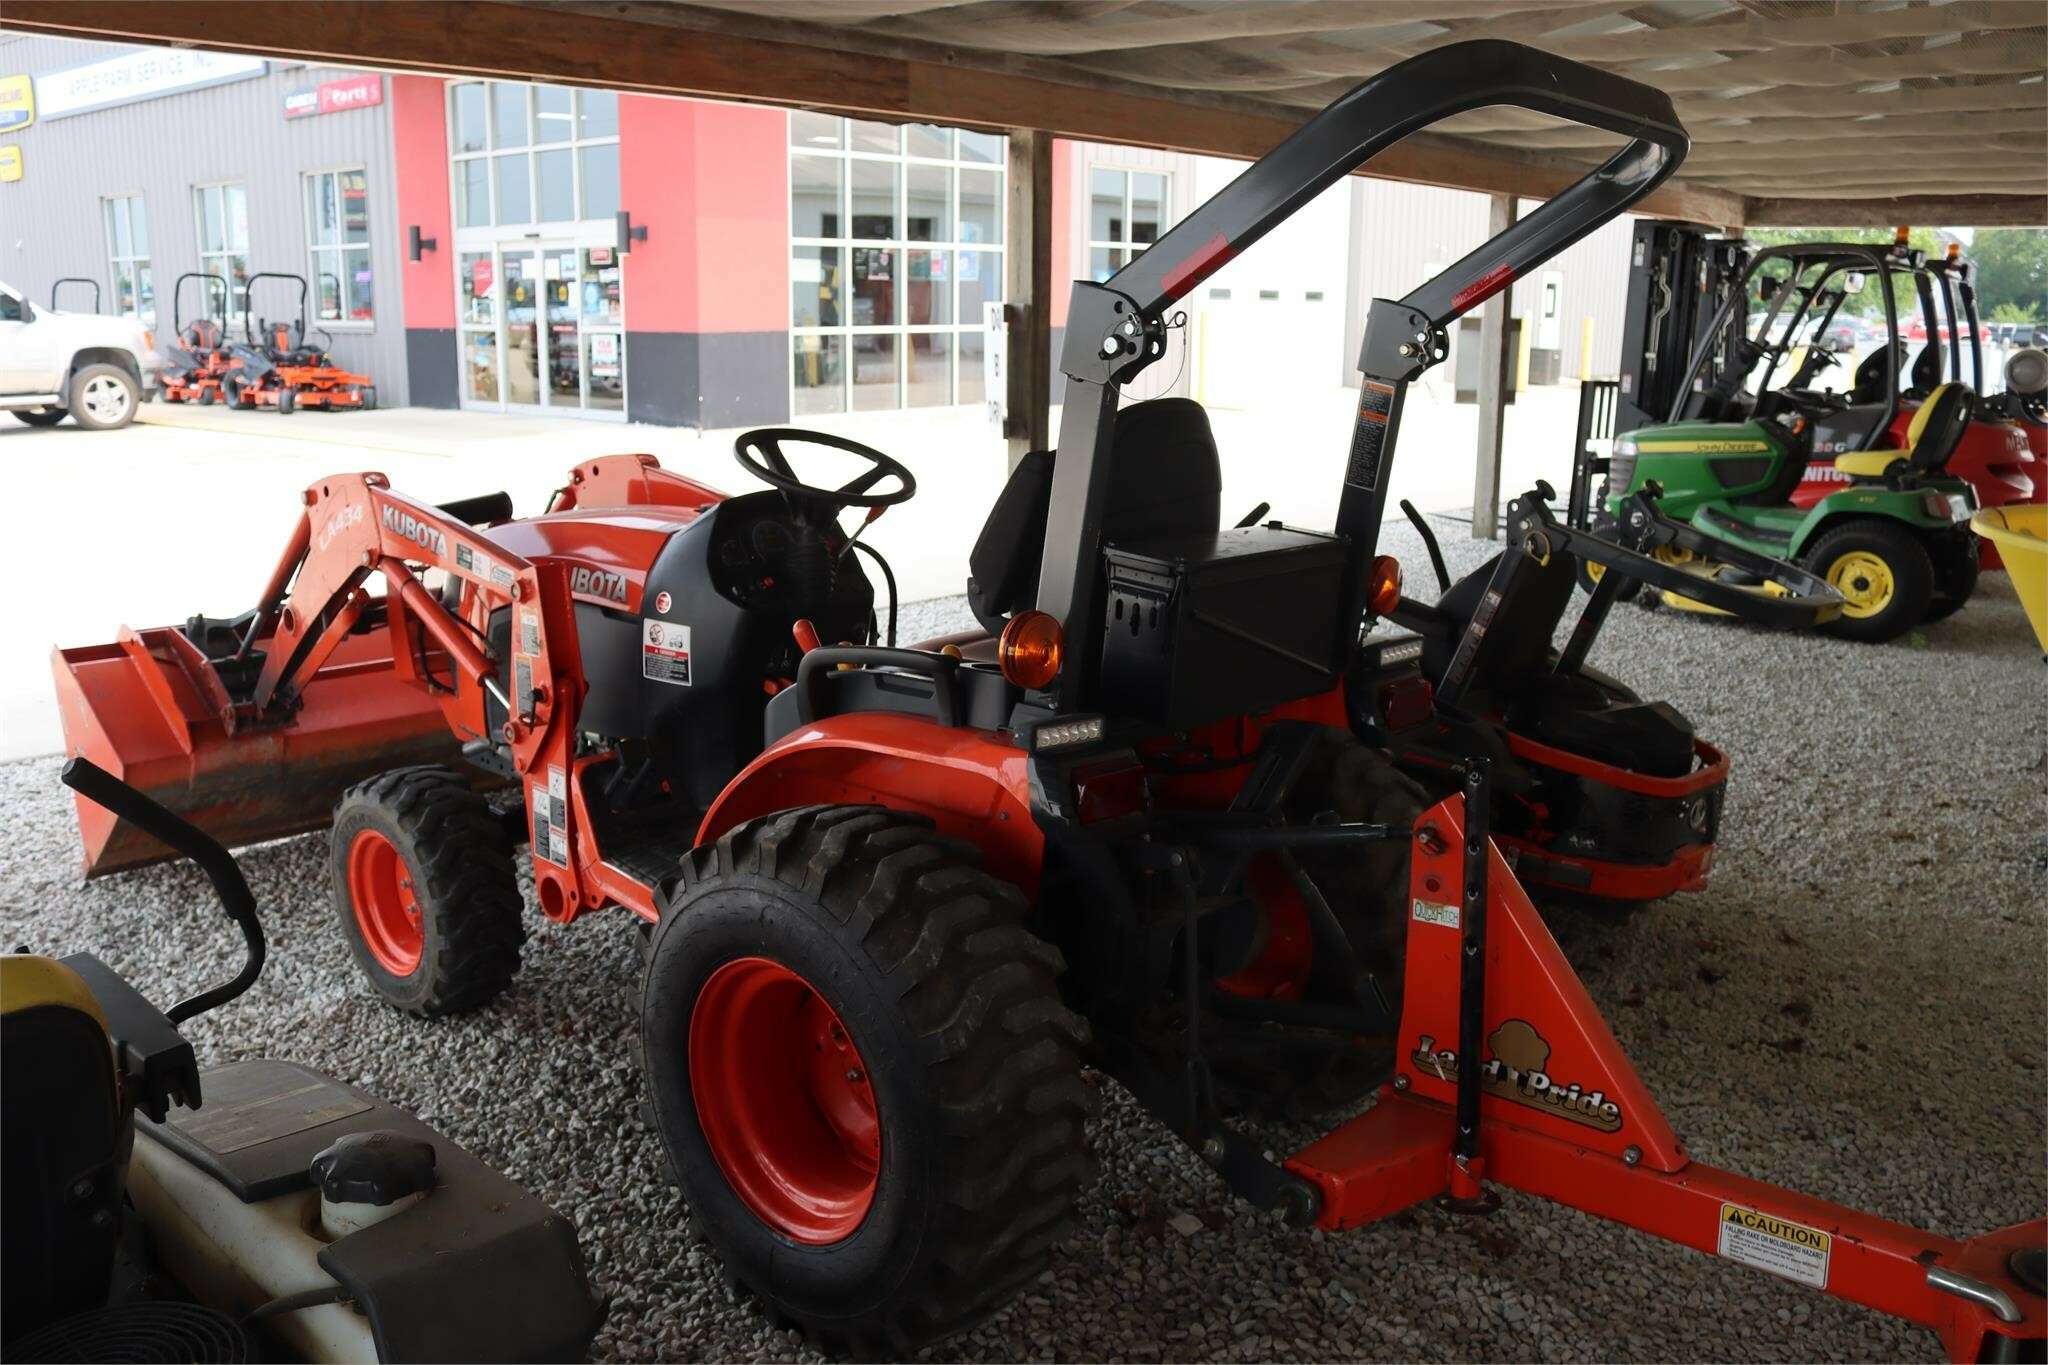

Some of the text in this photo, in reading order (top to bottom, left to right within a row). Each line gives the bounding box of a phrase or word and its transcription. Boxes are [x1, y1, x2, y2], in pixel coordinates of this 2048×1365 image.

[136, 54, 184, 83] SERVICE
[1723, 441, 1757, 451] DEERE
[1801, 465, 1854, 482] NITO
[381, 503, 449, 556] KUBOTA
[570, 566, 628, 602] BOTA
[1416, 1034, 1620, 1122] Lad Pride
[1725, 1224, 1746, 1237] FALLING
[1746, 1230, 1759, 1241] RAKE
[1760, 1235, 1769, 1243] OR
[1801, 1247, 1823, 1261] HAZARD
[1744, 1214, 1821, 1247] CAUTION
